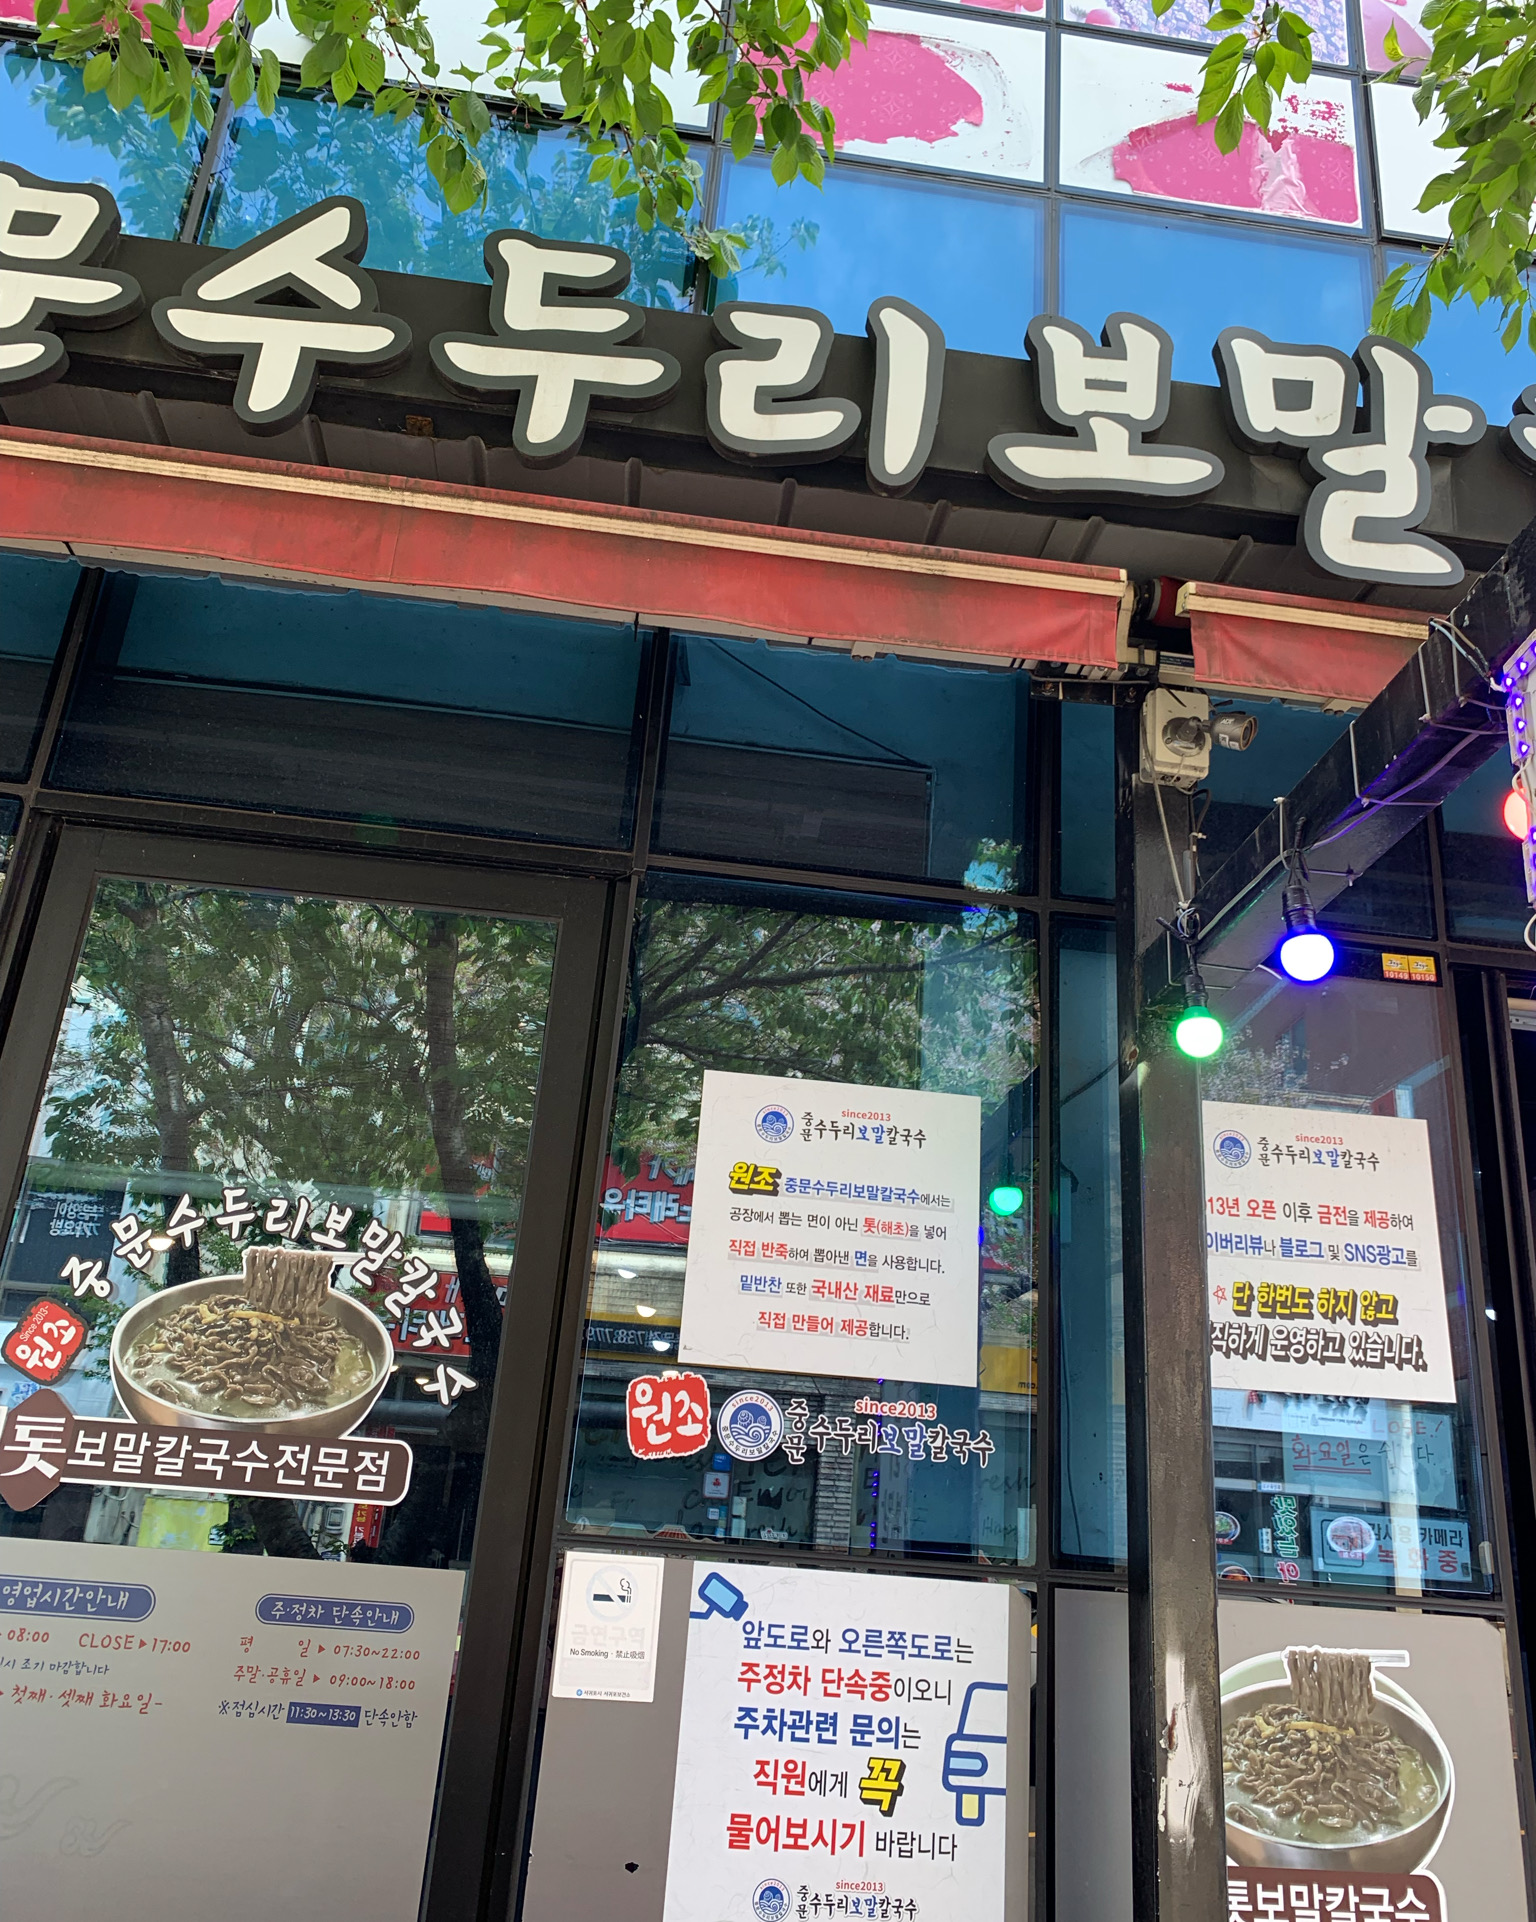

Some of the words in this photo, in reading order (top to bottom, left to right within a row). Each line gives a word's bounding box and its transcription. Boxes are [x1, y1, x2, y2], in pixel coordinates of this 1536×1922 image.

[841, 1109, 892, 1122] since2013
[1295, 1133, 1344, 1146] since2013
[729, 1161, 782, 1196] 원조
[784, 1177, 951, 1207] 중문수두리보말칼국수에서는
[729, 1206, 774, 1225] 공장에서
[778, 1210, 803, 1228] 뽑는
[806, 1213, 831, 1230] 면이
[835, 1216, 859, 1233] 아닌
[862, 1217, 920, 1238] 톳(해초)을
[923, 1224, 947, 1240] 넣어
[1206, 1196, 1240, 1218] 13년
[1246, 1197, 1277, 1220] 오픈
[1282, 1201, 1313, 1224] 이후
[1317, 1203, 1360, 1227] 금전을
[1363, 1209, 1415, 1231] 제공하여
[729, 1239, 756, 1258] 직접
[761, 1241, 809, 1261] 반죽하여
[813, 1248, 849, 1266] 뽑아낸
[854, 1249, 879, 1268] 면을
[882, 1255, 945, 1275] 사용합니다.
[1279, 1237, 1325, 1260] 블로그
[1328, 1244, 1341, 1262] 및
[1344, 1242, 1418, 1267] SNS광고를
[740, 1274, 782, 1294] 밑반찬
[785, 1281, 807, 1296] 또한
[811, 1279, 859, 1301] 국내산
[864, 1284, 931, 1307] 재료만으로
[1232, 1281, 1254, 1315] 단
[1257, 1282, 1313, 1319] 한번도
[1317, 1286, 1357, 1323] 하지
[1359, 1290, 1398, 1326] 않고
[19, 1323, 37, 1342] Since
[757, 1311, 787, 1330] 직접
[791, 1314, 834, 1334] 만들어
[840, 1318, 909, 1340] 제공합니다.
[15, 1319, 77, 1369] 원조
[1209, 1320, 1268, 1360] 직하게
[1270, 1325, 1344, 1364] 운영하고
[1348, 1331, 1427, 1371] 있습니다.
[632, 1382, 704, 1445] 원조
[855, 1397, 937, 1419] since2013
[1291, 1434, 1371, 1467] 화요일은
[1419, 1527, 1463, 1548] 카메라
[3, 1582, 129, 1612] 영업시간안내
[332, 1606, 400, 1626] 단속안내
[7, 1628, 50, 1643] 08:00
[78, 1633, 135, 1650] CLOSE
[152, 1637, 191, 1654] 17:00
[742, 1620, 831, 1654] 앞도로와
[838, 1628, 974, 1664] 오른쪽도로는
[21, 1658, 45, 1671] 조기
[49, 1660, 110, 1675] 마감합니다
[333, 1645, 420, 1660] 07:30~22:00
[569, 1648, 580, 1656] No
[580, 1649, 609, 1659] Smoking
[329, 1674, 416, 1690] 09:00~18:00
[737, 1662, 811, 1696] 주정차
[821, 1667, 952, 1705] 단속중이오니
[289, 1705, 357, 1721] 11:30~13:30
[364, 1708, 418, 1729] 단속안함
[734, 1706, 838, 1745] 주차관련
[850, 1713, 921, 1750] 문의는
[753, 1759, 848, 1798] 직원에게
[859, 1757, 906, 1817] 꼭
[726, 1813, 865, 1858] 물어보시기
[876, 1829, 957, 1861] 바랍니다
[835, 1880, 884, 1893] since2013
